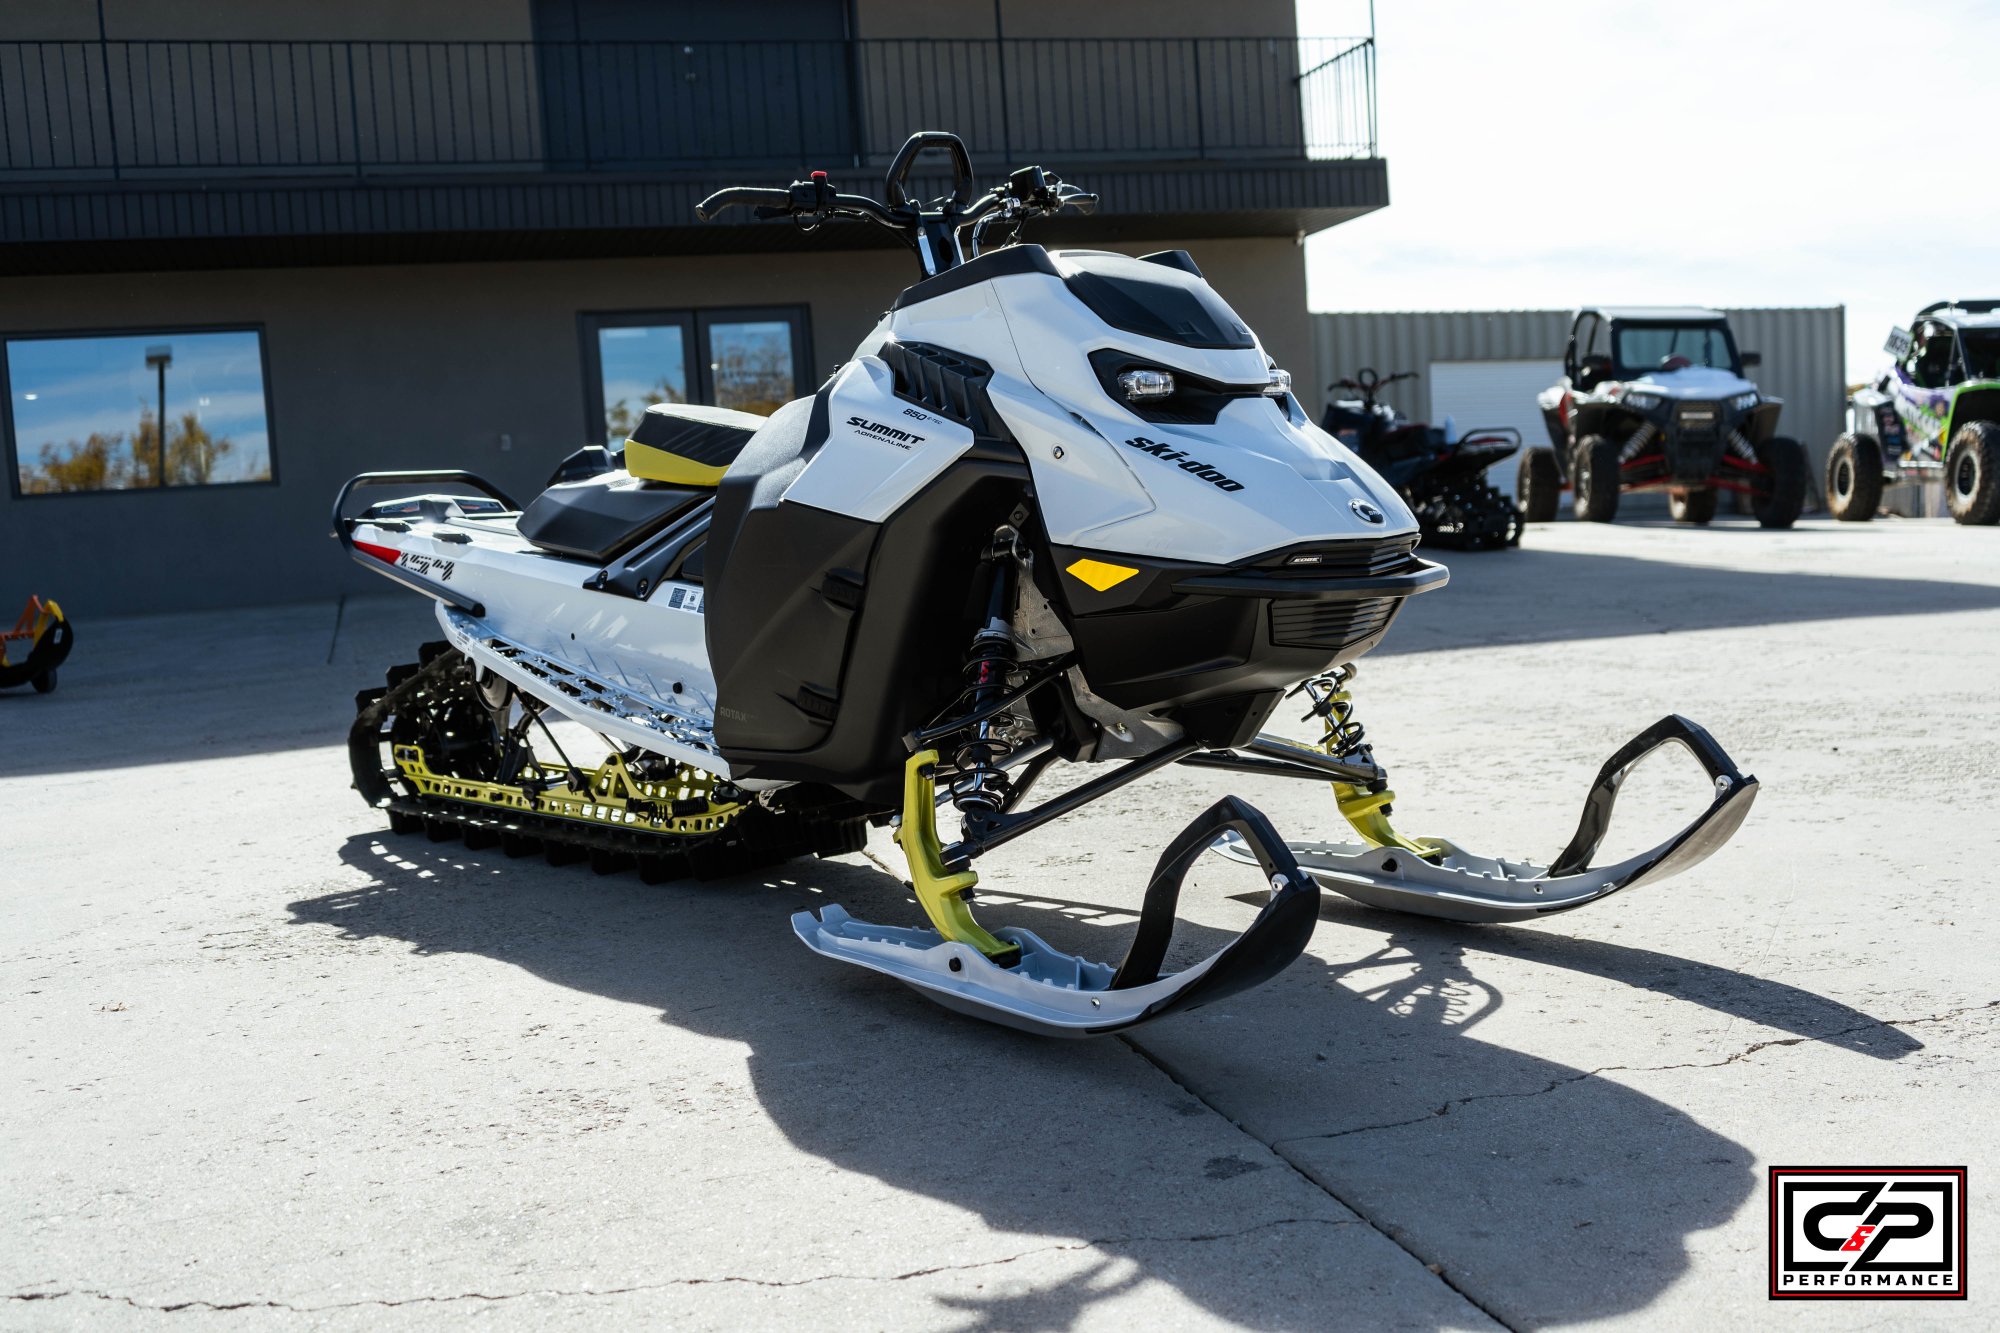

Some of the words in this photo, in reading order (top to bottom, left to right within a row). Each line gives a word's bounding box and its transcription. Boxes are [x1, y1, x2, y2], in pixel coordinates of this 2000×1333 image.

[903, 408, 927, 421] 850
[846, 416, 926, 444] SUMMIT
[855, 429, 912, 450] ADRENALINE
[720, 706, 747, 721] ROTAX
